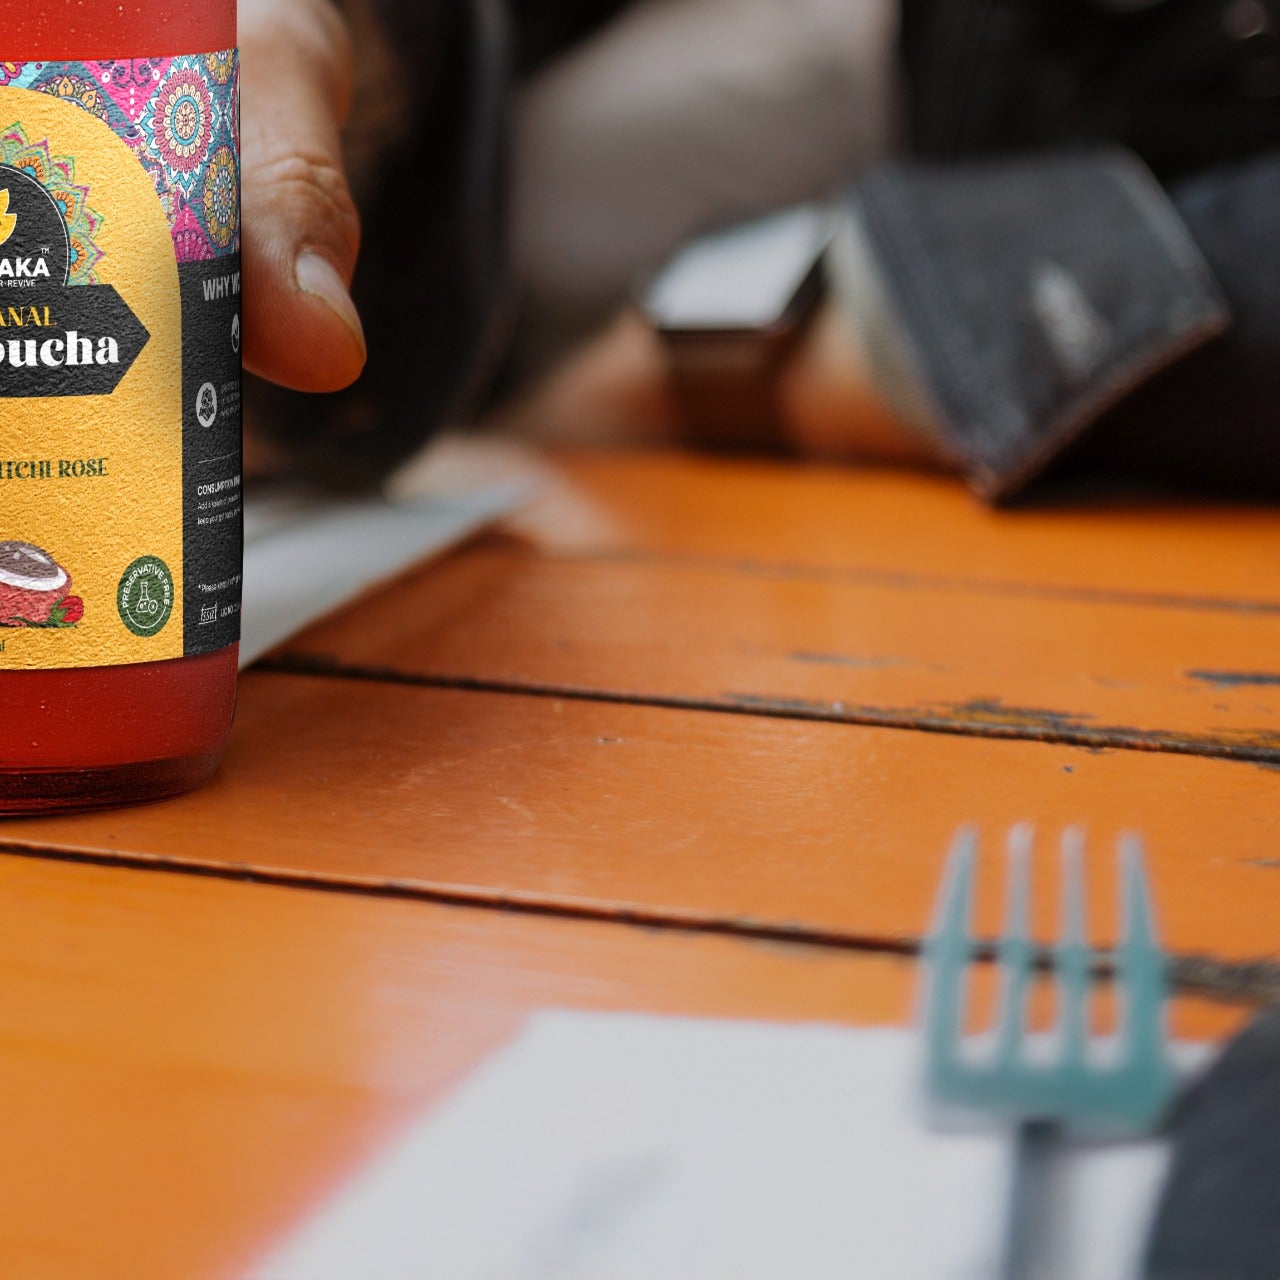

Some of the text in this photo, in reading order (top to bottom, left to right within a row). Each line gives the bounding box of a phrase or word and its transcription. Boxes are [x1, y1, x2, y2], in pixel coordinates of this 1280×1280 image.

[7, 279, 36, 287] REVIVE
[202, 274, 230, 301] WHY
[58, 458, 109, 478] ROSE
[122, 564, 170, 608] PRESERVATIVE FREE
